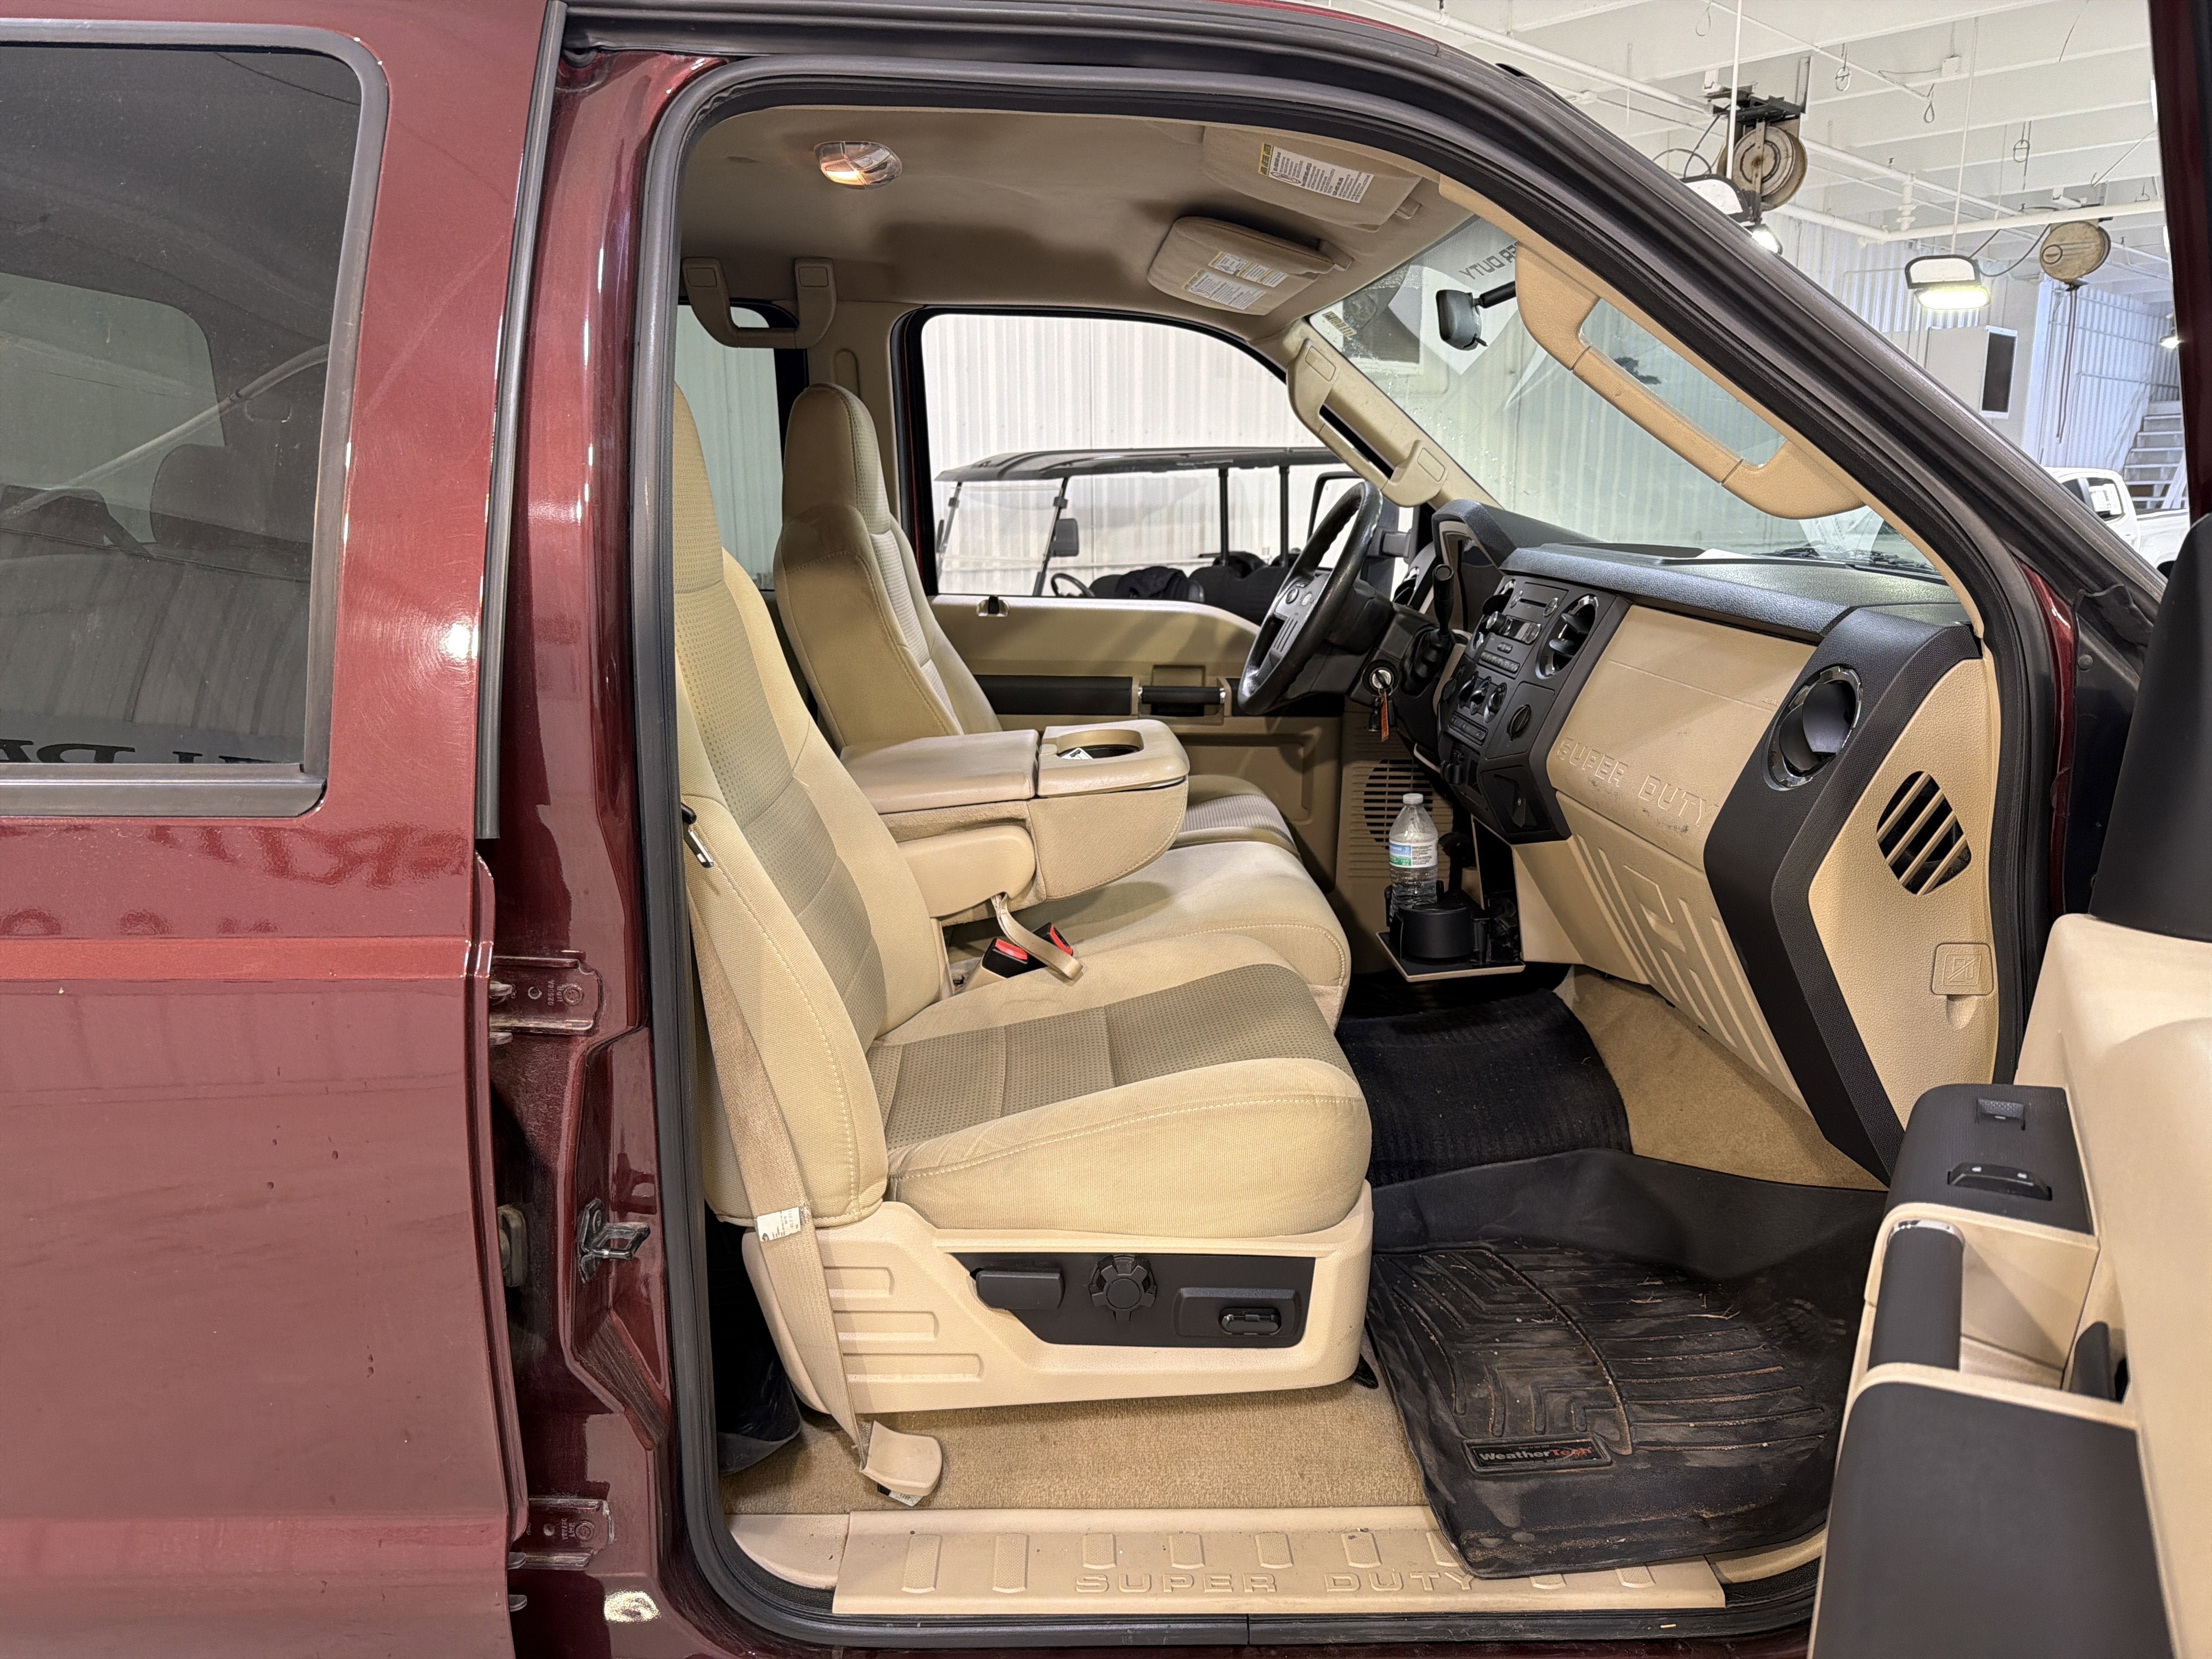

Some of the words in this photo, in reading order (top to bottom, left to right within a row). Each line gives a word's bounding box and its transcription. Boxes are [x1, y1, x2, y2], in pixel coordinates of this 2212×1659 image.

[1556, 737, 1628, 788] SUPER
[1638, 774, 1719, 827] DUTY
[1479, 1447, 1593, 1461] WeatherTech
[1076, 1573, 1277, 1593] SUPER
[1324, 1571, 1474, 1592] DUTY
